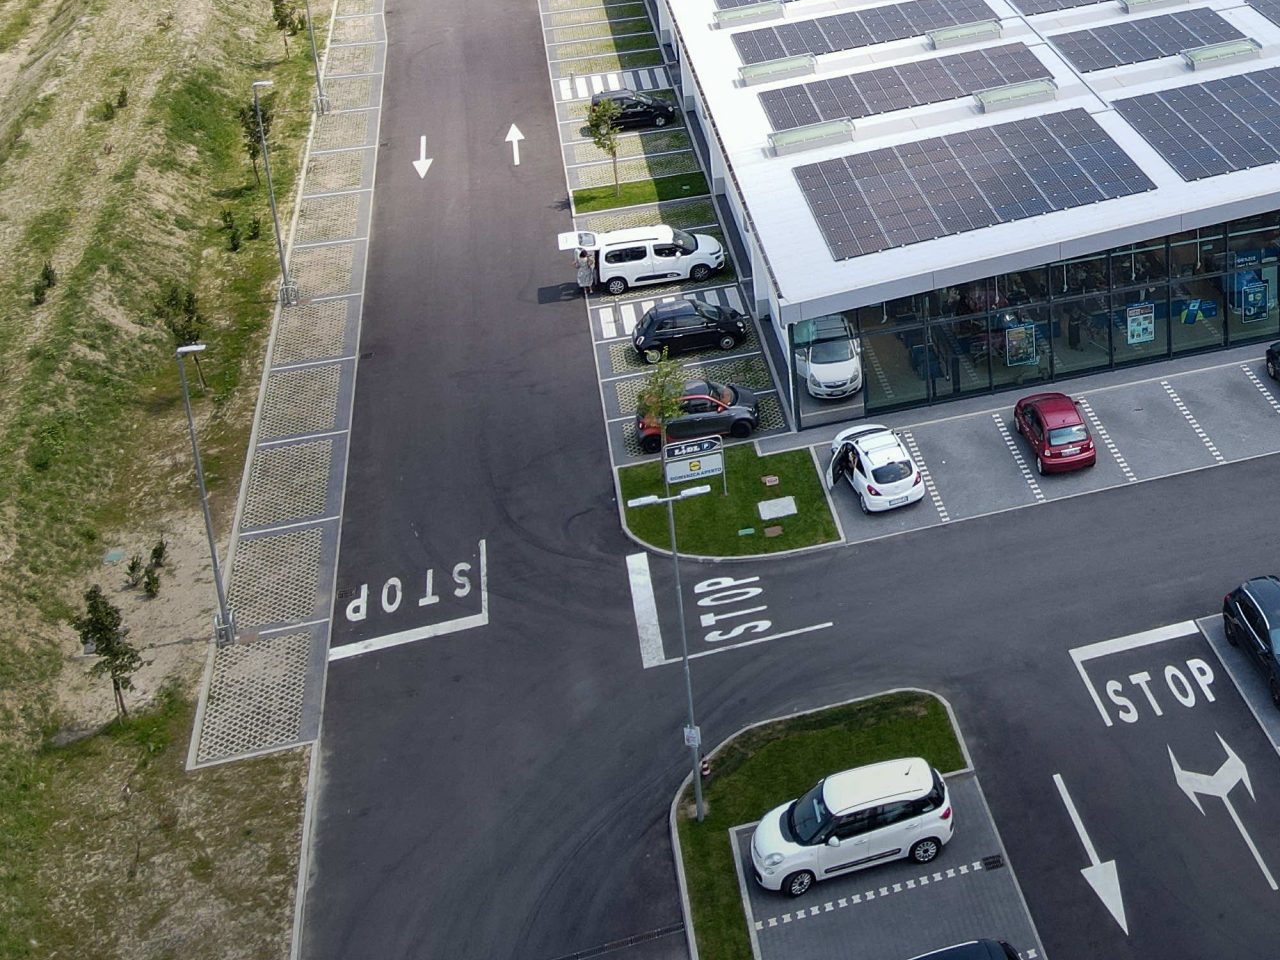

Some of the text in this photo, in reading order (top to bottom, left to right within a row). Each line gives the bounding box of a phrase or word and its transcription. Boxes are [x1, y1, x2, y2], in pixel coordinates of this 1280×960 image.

[345, 561, 472, 621] STOP
[693, 575, 773, 644] STOP
[1106, 658, 1216, 724] STOP
